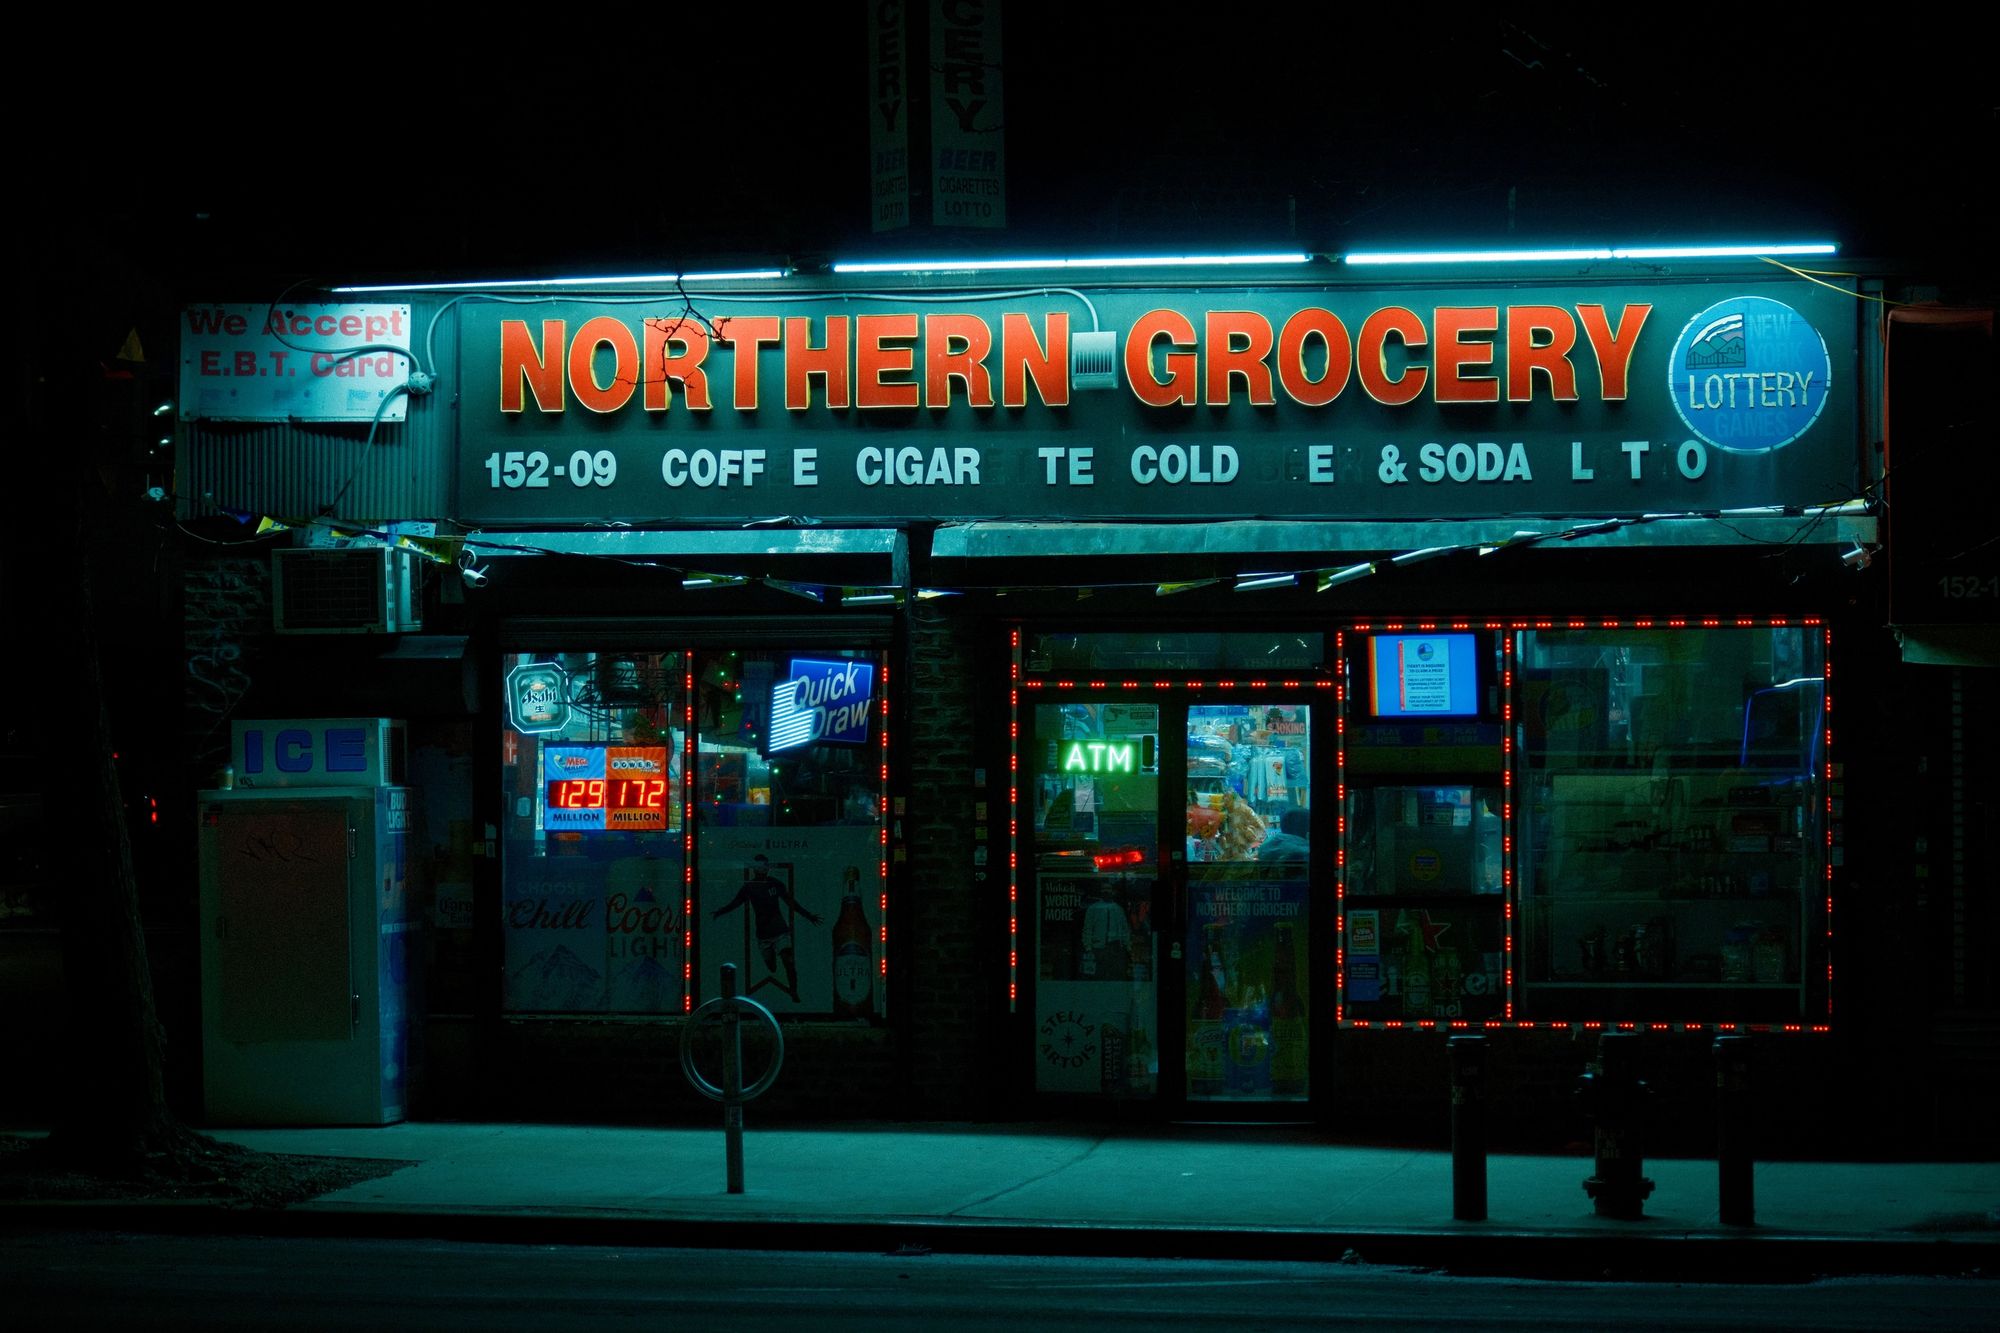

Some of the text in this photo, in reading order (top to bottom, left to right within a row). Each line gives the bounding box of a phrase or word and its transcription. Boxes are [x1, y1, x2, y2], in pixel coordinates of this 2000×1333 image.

[940, 149, 997, 171] BEER
[940, 178, 999, 195] CIGARETTES
[944, 201, 992, 218] LOTTO
[187, 309, 402, 341] We Accept
[1749, 314, 1793, 337] NEW
[201, 351, 394, 377] E.B.T. Card
[500, 303, 1653, 413] NORTHERN GROCERY
[1689, 372, 1814, 410] LOTTERY
[1715, 413, 1788, 438] GAMES
[485, 449, 617, 488] 152-09
[1130, 444, 1239, 485] COLD
[1379, 444, 1408, 485] &
[1419, 442, 1532, 484] SODA
[1938, 575, 1999, 599] 152-1
[521, 686, 557, 704] Asahi
[791, 661, 860, 711] Quick
[809, 699, 871, 740] Draw
[244, 728, 368, 774] ICE
[1064, 741, 1134, 773] ATM
[611, 759, 654, 770] POWER
[559, 780, 605, 807] 129
[619, 780, 665, 807] 172
[552, 812, 600, 822] MILLION
[613, 812, 660, 822] MILLION
[771, 839, 809, 849] ULTRA
[1044, 894, 1081, 908] WORTH
[1215, 887, 1280, 901] WELCOME TO
[508, 897, 597, 929] Chill
[1045, 908, 1074, 921] MORE
[1196, 902, 1300, 917] NORTHERN GROCERY
[1041, 1010, 1095, 1037] STELLA
[1040, 1043, 1096, 1068] ARTOIS
